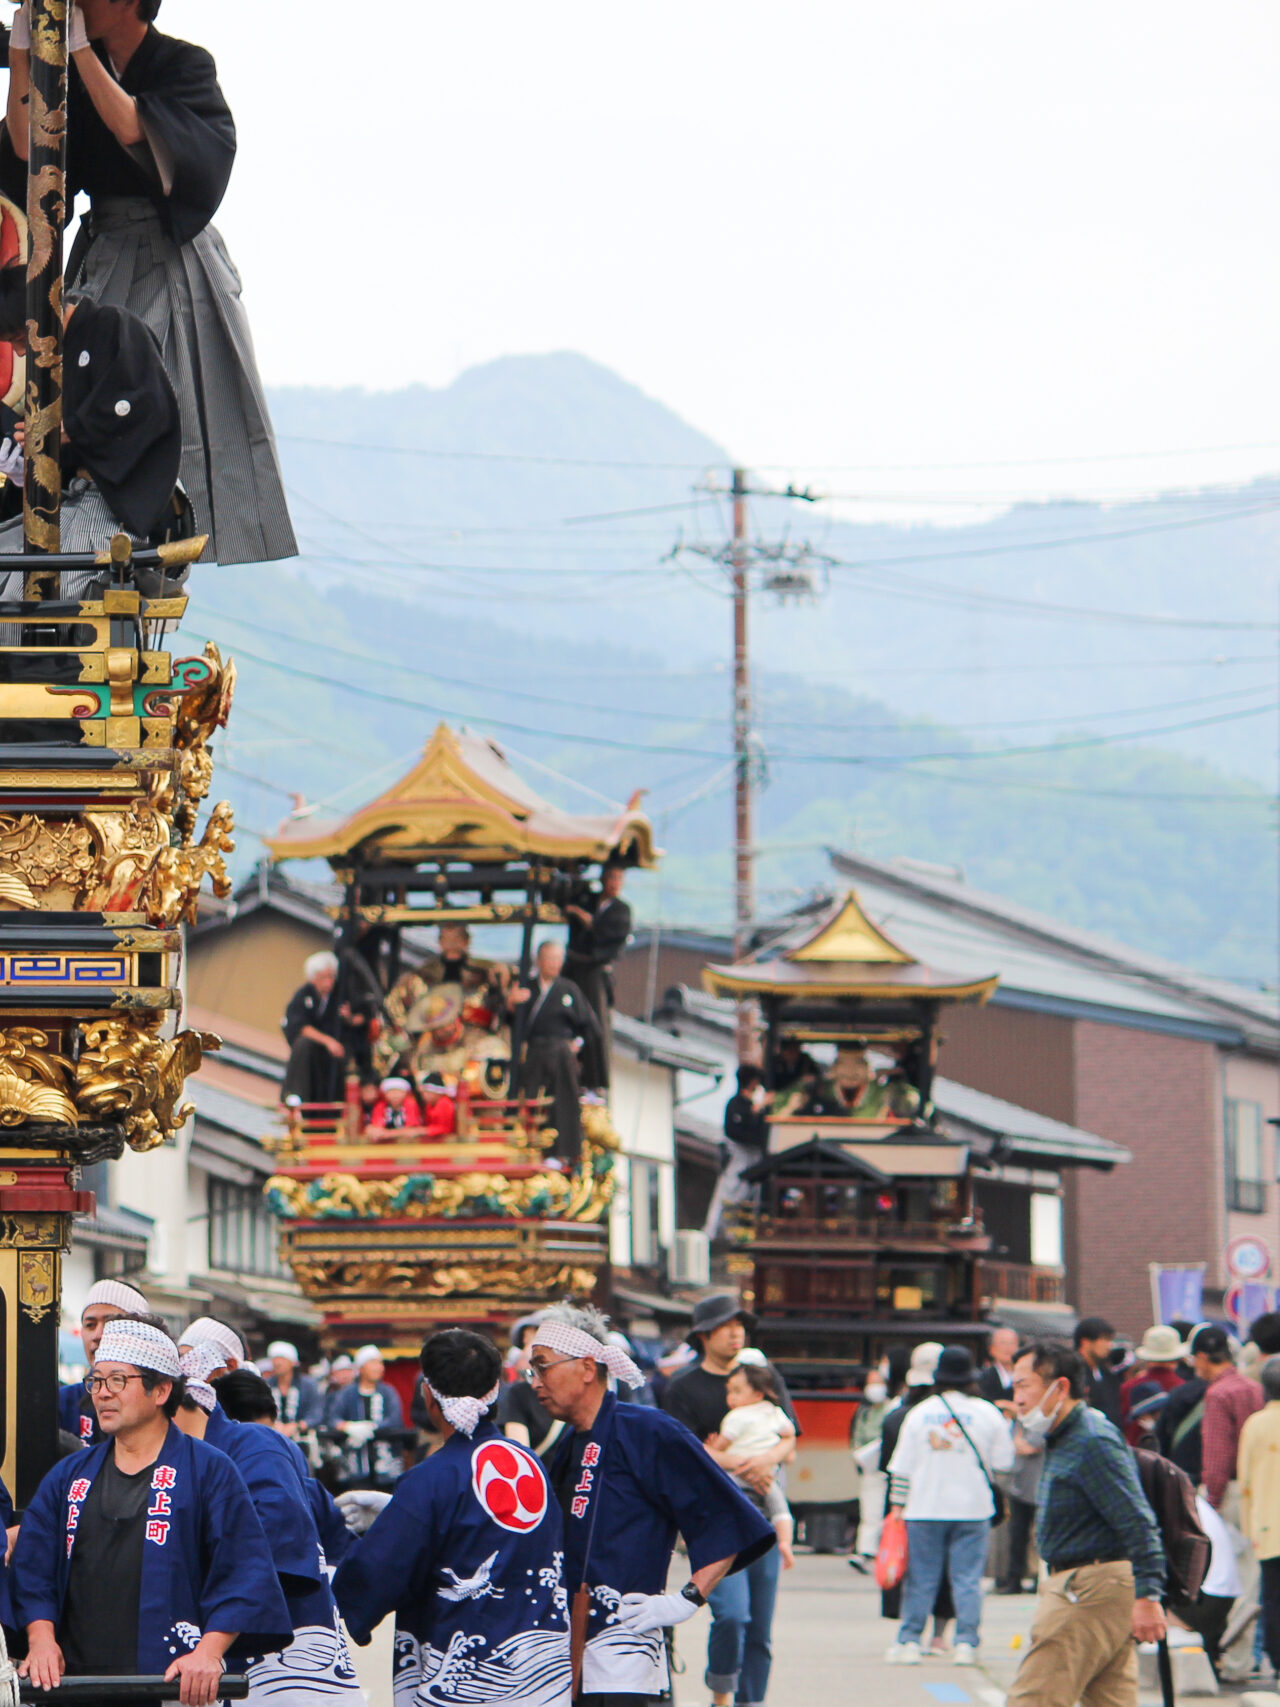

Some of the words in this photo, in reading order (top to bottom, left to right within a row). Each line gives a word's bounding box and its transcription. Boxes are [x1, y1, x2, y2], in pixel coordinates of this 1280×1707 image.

[146, 1465, 176, 1546] 東上町
[571, 1442, 601, 1518] 東上町
